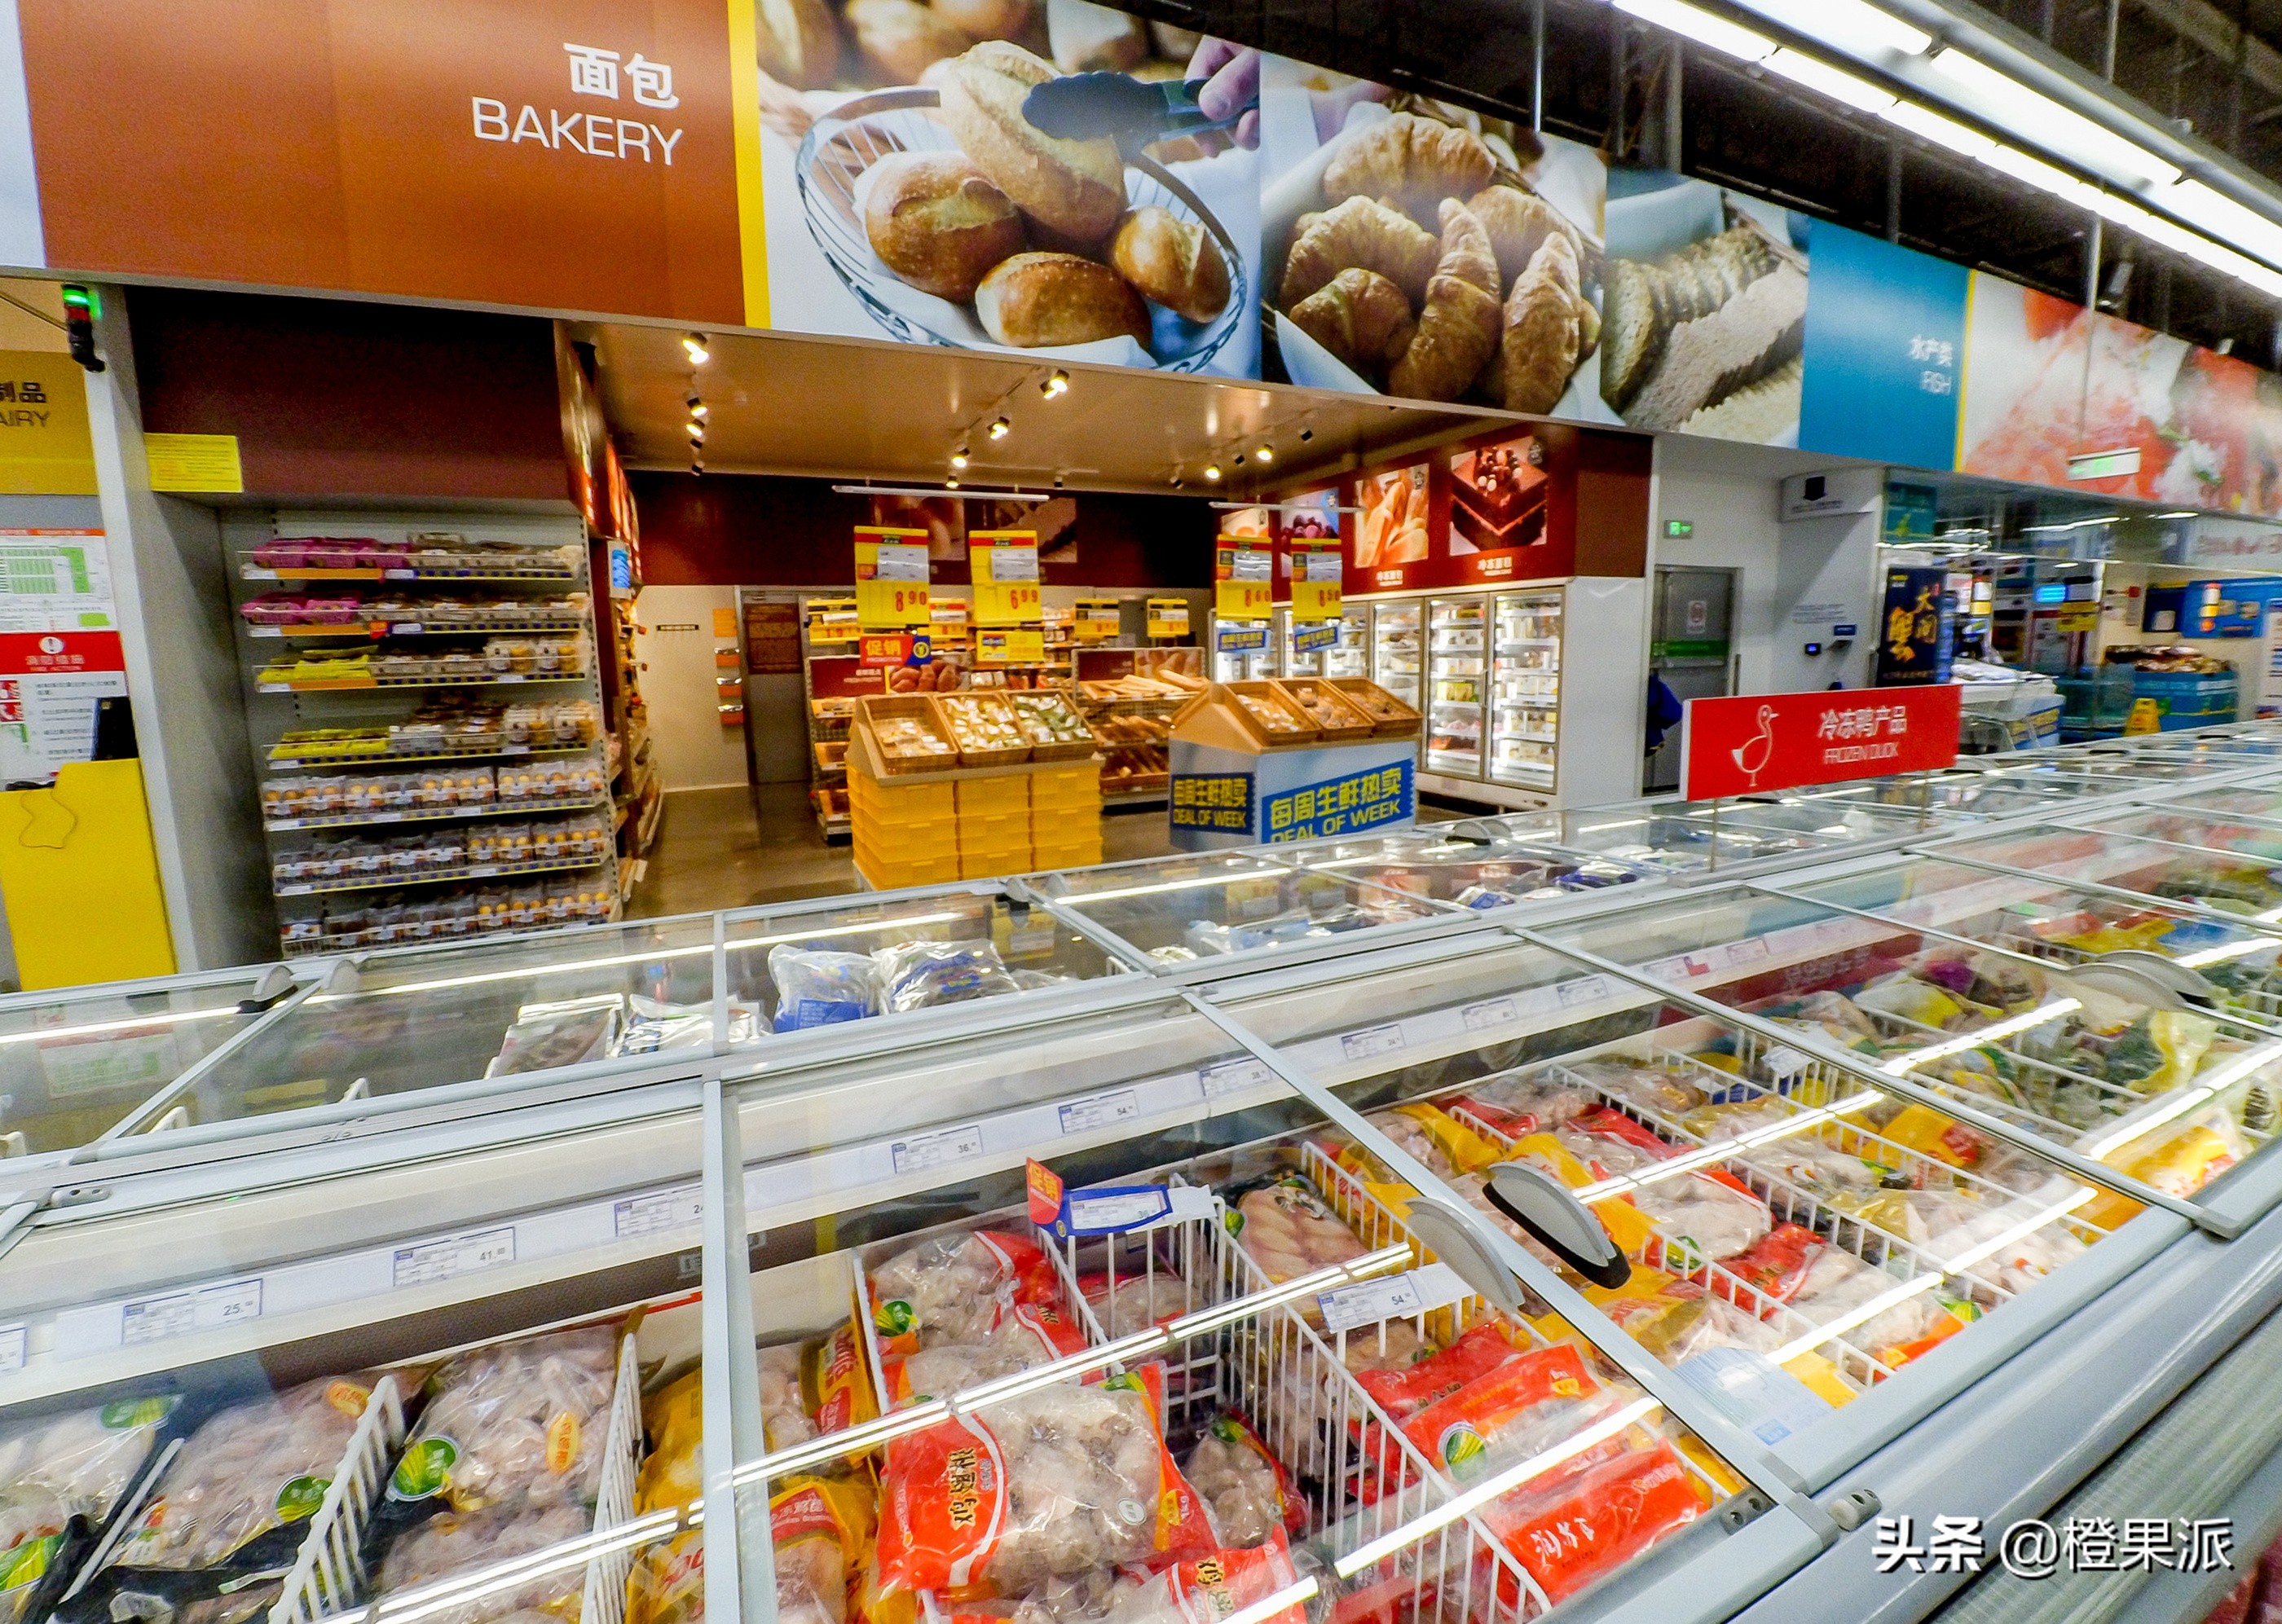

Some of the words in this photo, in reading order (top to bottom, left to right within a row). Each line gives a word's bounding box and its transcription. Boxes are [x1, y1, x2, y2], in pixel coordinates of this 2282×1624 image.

[563, 42, 680, 109] 面包
[472, 96, 683, 166] BAKERY
[1174, 808, 1196, 825] DEAL
[1198, 810, 1212, 825] OF
[1214, 811, 1247, 828] WEEK
[1271, 768, 1402, 830] 每周生鲜热卖
[1323, 814, 1346, 835] OF
[1350, 798, 1401, 827] WEEK
